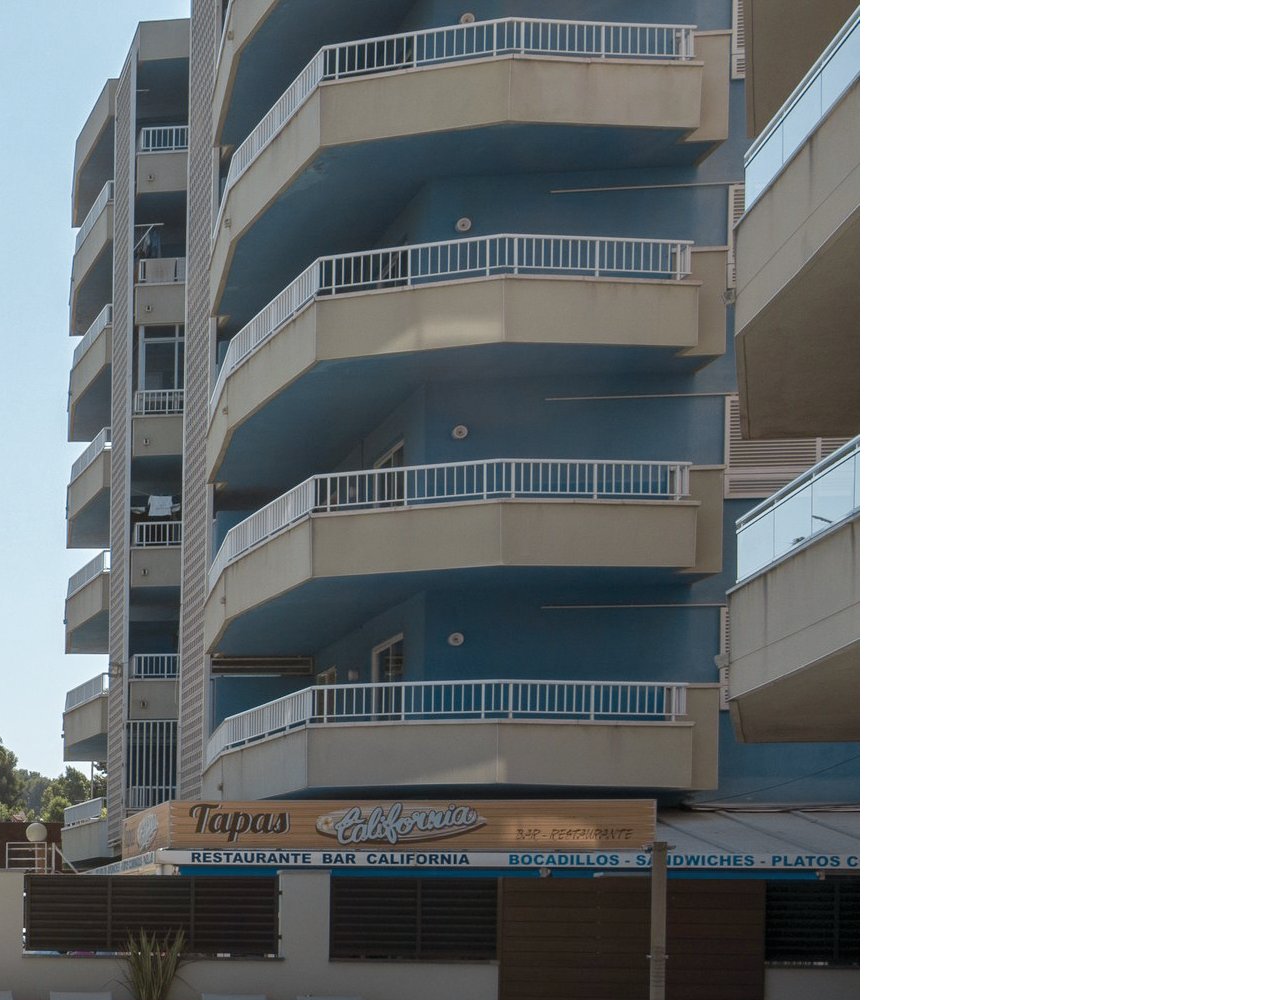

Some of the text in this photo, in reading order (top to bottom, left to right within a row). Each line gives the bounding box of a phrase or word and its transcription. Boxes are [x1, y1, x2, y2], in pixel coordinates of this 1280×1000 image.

[189, 804, 291, 843] Tapas
[334, 801, 479, 845] California
[191, 852, 470, 865] RESTAURANTE BAR CALIFORNIA
[508, 854, 620, 866] BOCADILLOS
[771, 855, 841, 867] PLATOS
